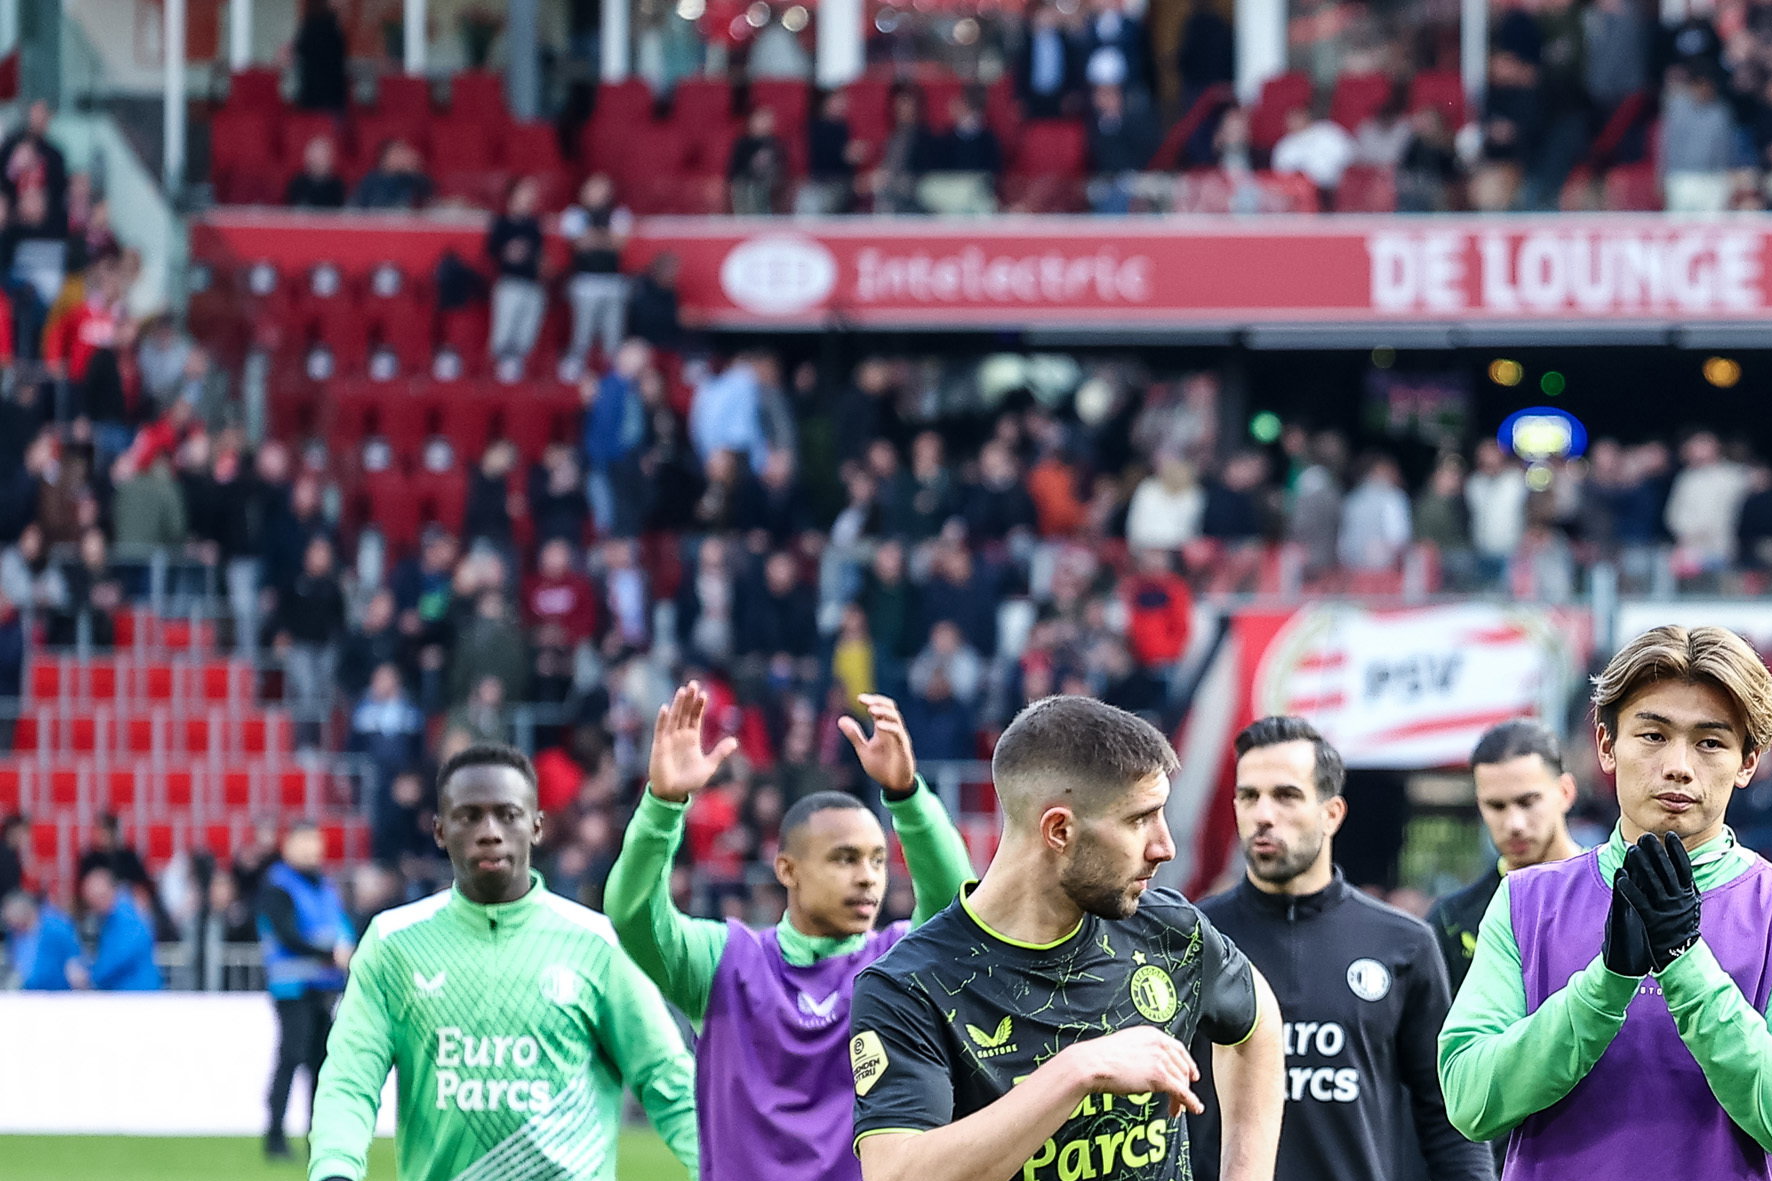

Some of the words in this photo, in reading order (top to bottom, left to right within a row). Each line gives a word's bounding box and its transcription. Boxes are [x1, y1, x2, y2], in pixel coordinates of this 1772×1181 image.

[1369, 231, 1470, 315] DE
[1482, 231, 1765, 315] LOUNGE
[1364, 650, 1463, 702] PSV
[434, 1026, 540, 1068] Euro
[434, 1070, 552, 1113] Parcs
